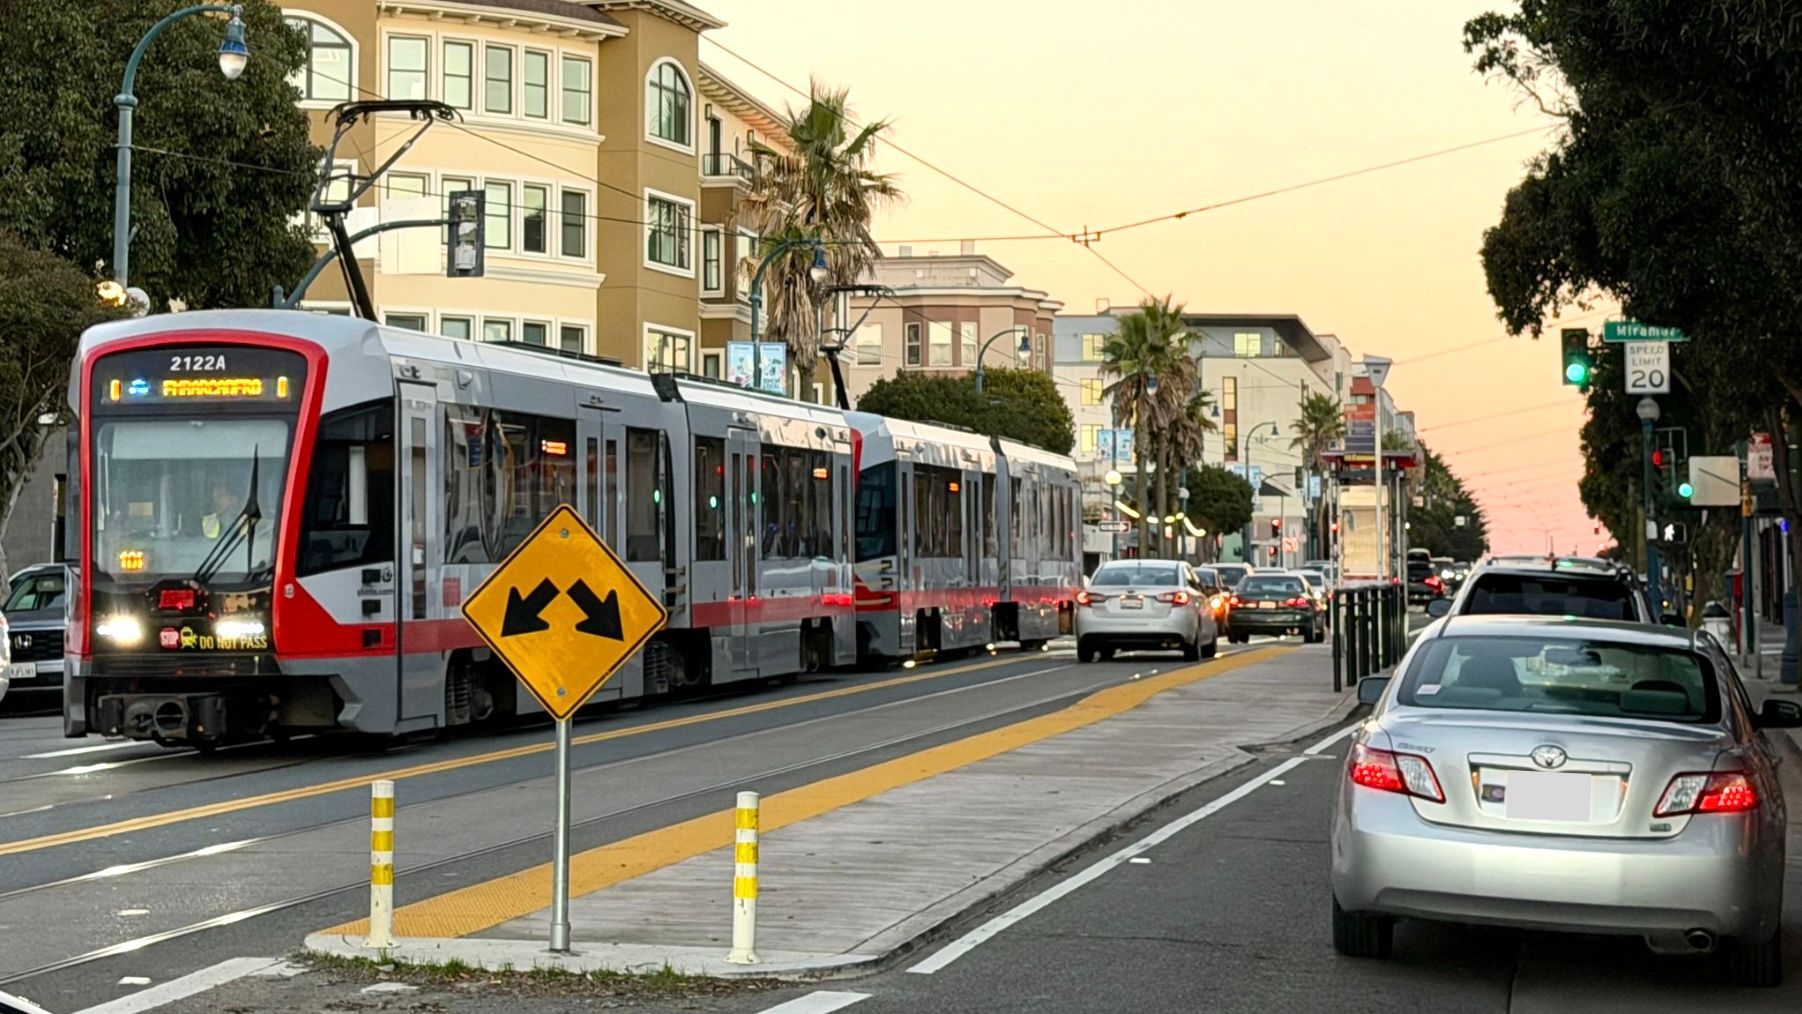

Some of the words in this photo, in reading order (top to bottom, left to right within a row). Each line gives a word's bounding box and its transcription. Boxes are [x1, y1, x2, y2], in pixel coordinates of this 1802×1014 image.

[1630, 346, 1664, 355] SPEED
[170, 355, 226, 371] 2122A
[1632, 357, 1662, 366] LIMIT
[1631, 369, 1665, 388] 20
[160, 630, 179, 646] STOP
[199, 636, 214, 650] DO
[217, 636, 238, 650] NOT
[240, 635, 268, 649] PASS
